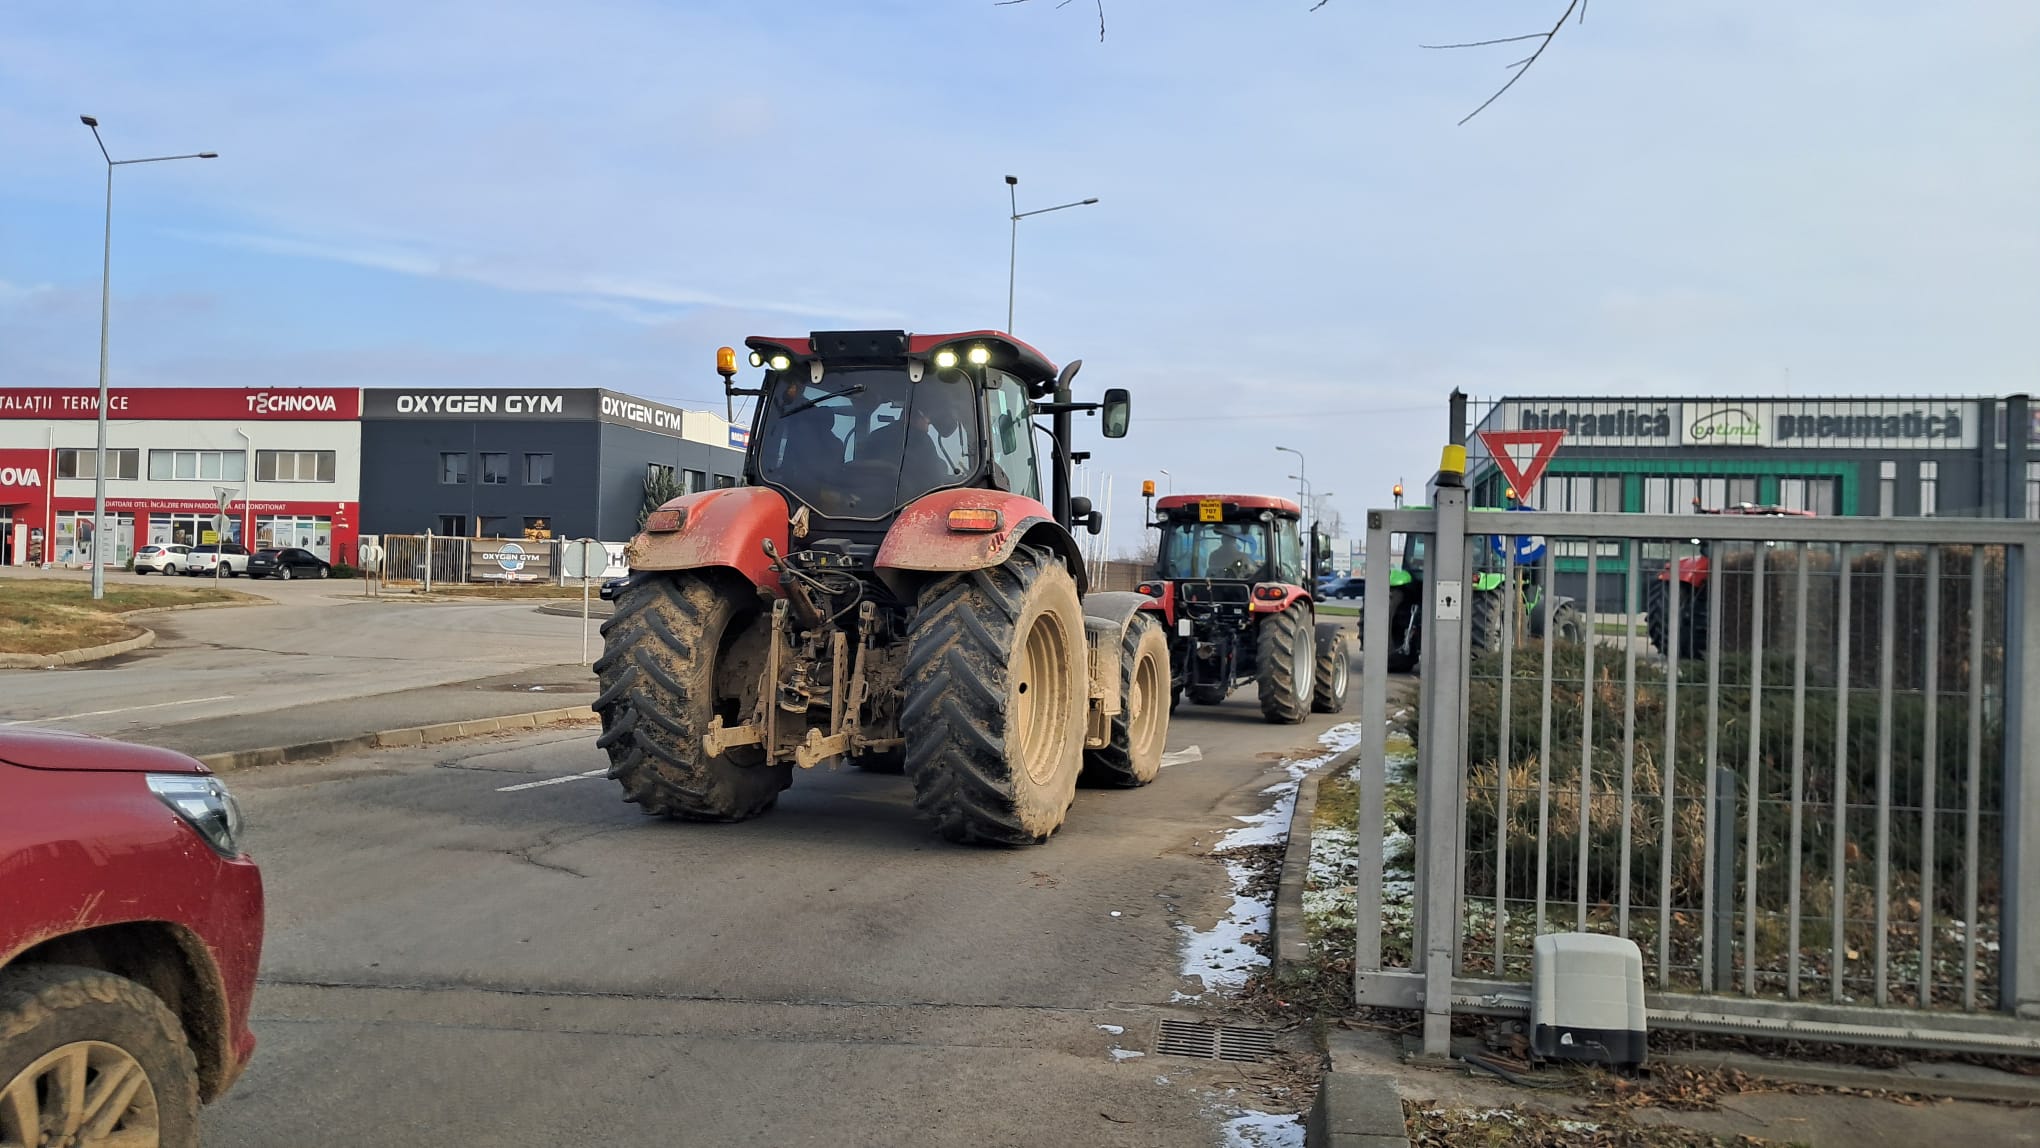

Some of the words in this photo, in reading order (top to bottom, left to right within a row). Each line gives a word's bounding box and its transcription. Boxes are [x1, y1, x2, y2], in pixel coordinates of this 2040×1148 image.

[62, 396, 128, 410] TERMCE
[246, 392, 337, 414] TECHNOVA
[397, 395, 497, 413] OXYGEN
[505, 395, 563, 413] GYM
[602, 396, 653, 424] OXYGEN
[655, 412, 681, 431] GYM
[1778, 408, 1961, 441] pneumatică
[0, 467, 41, 487] OVA
[482, 553, 518, 561] OXYGEN
